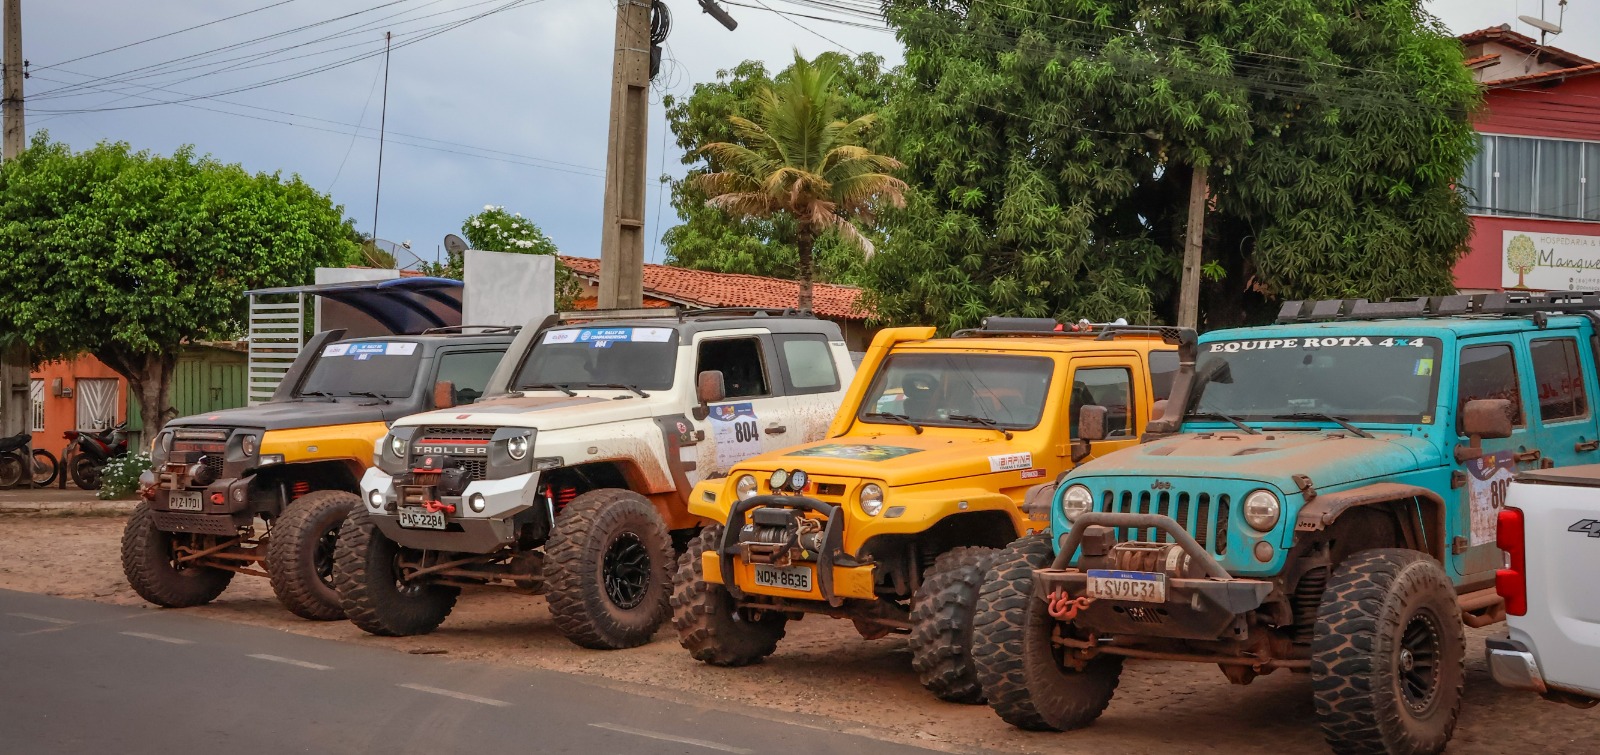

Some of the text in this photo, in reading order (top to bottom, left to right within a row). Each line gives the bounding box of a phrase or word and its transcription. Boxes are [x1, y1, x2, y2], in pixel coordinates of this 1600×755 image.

[1541, 236, 1596, 247] HOSPEDARIA &
[1209, 337, 1424, 353] EQUIPE ROTA 4x4
[735, 421, 759, 442] 804
[415, 446, 487, 454] TROLLER
[1151, 479, 1175, 490] Jee
[1298, 521, 1315, 529] Jeep
[1568, 519, 1600, 538] 4
